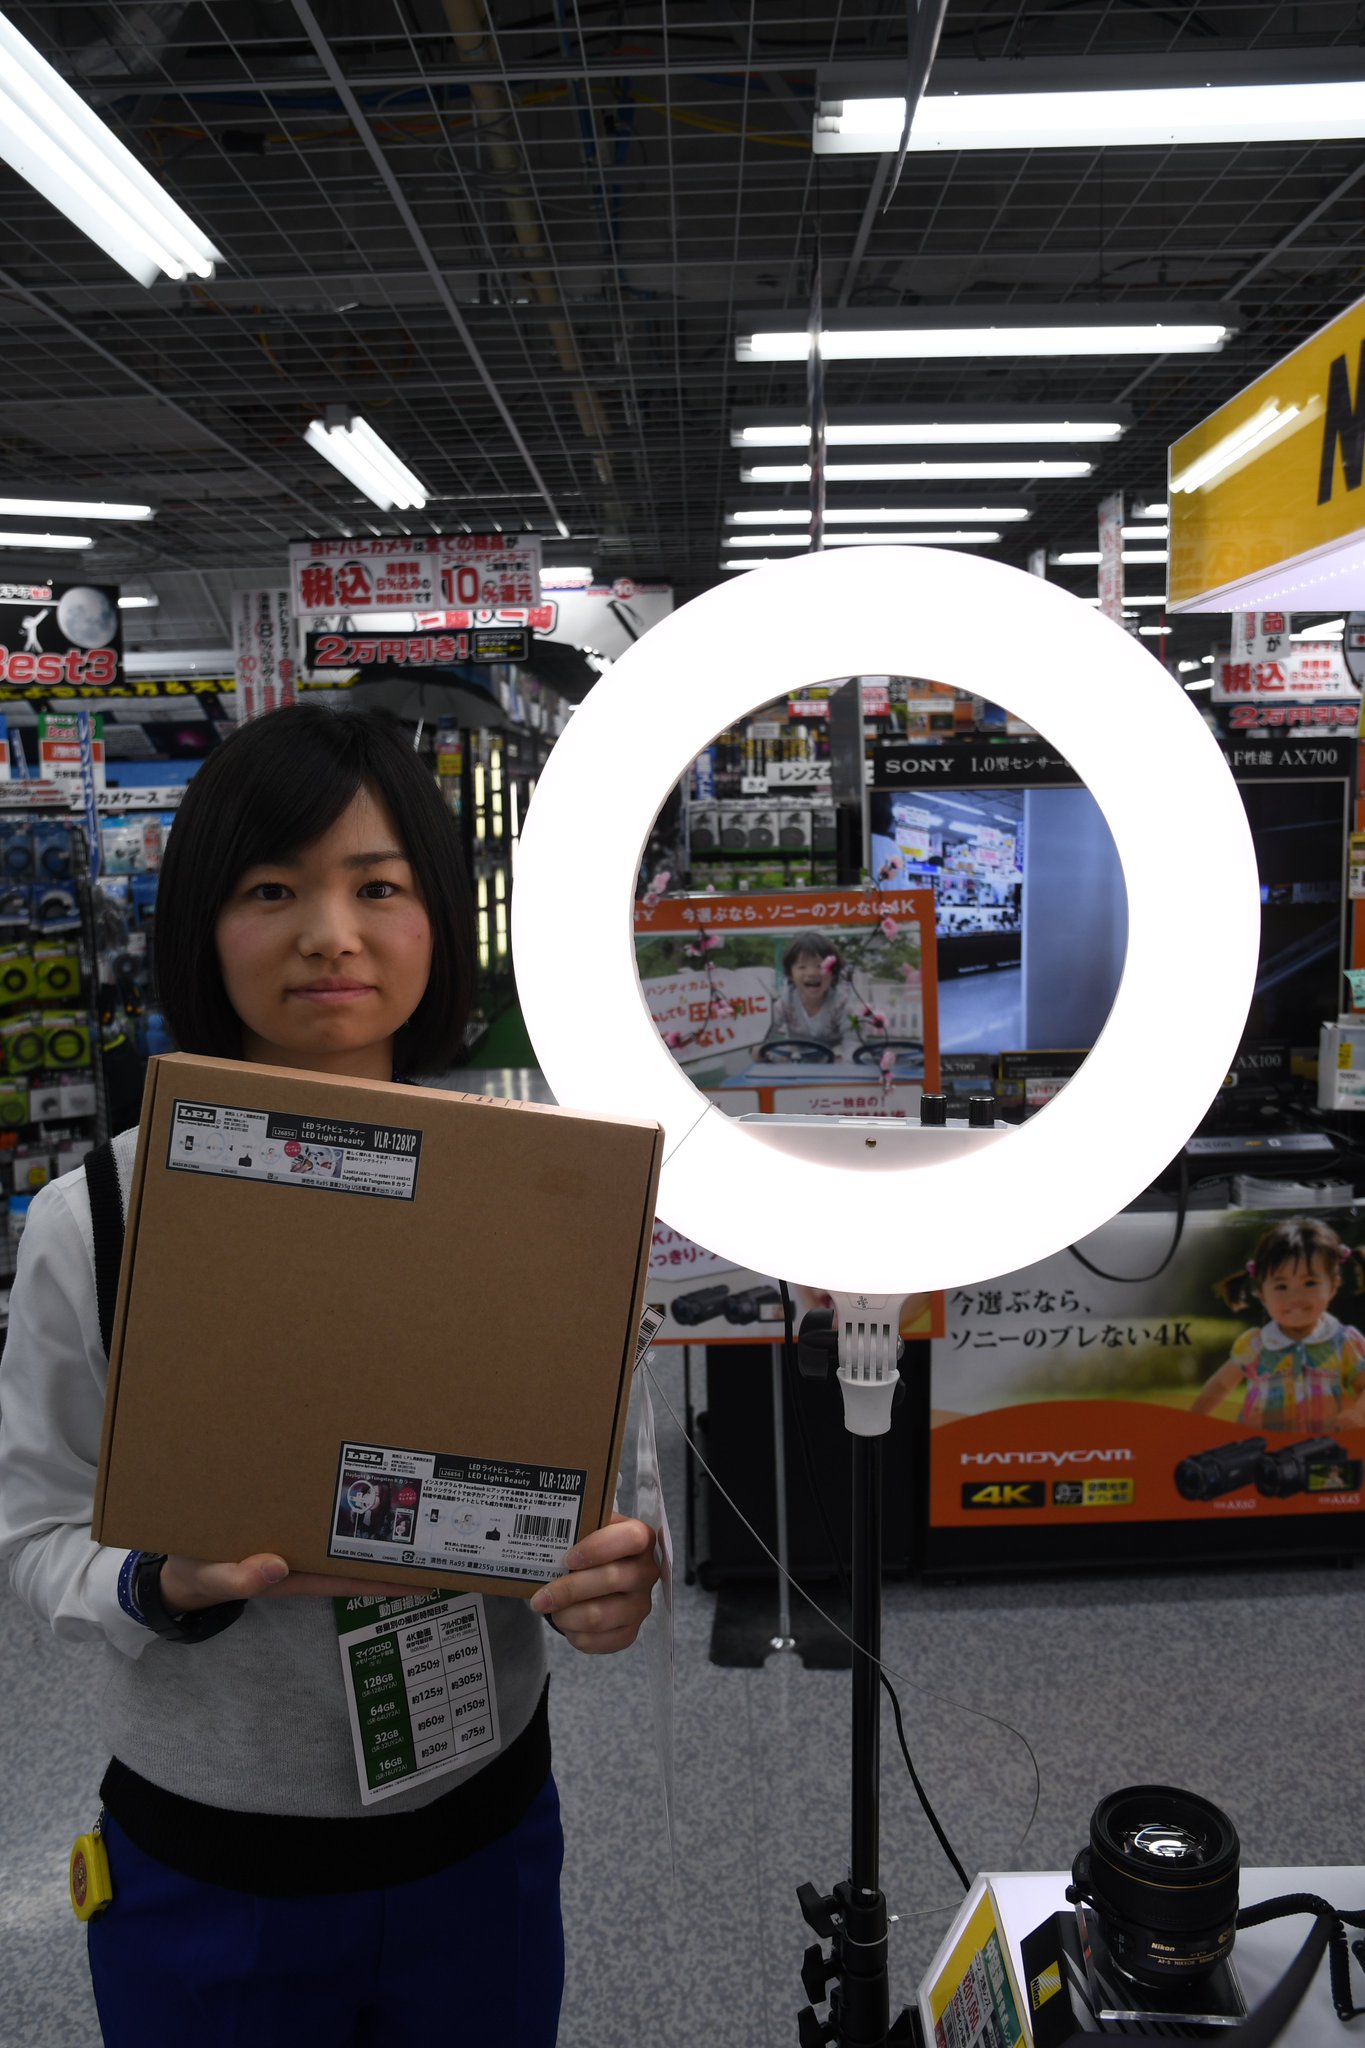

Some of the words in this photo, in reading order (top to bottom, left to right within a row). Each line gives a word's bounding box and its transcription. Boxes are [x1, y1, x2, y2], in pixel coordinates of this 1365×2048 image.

[301, 565, 373, 608] 税込
[1222, 662, 1285, 693] 税込
[885, 758, 955, 774] SONY
[1279, 750, 1338, 765] AX700
[1237, 1055, 1282, 1068] AX100
[274, 1129, 295, 1138] L26854
[302, 1122, 315, 1130] LED
[315, 1123, 366, 1135] ライトビューティー
[301, 1131, 316, 1140] LED
[317, 1133, 337, 1143] Light
[338, 1135, 366, 1147] Beauty
[374, 1130, 417, 1151] VLR-128XP
[342, 1174, 363, 1184] Daylight
[368, 1178, 391, 1187] Tungsten
[950, 1290, 1092, 1316] 今選ぶなら、
[950, 1323, 1192, 1350] ソニーのブレない4K
[960, 1449, 1132, 1466] HANDYCAM
[469, 1463, 481, 1471] LED
[482, 1464, 531, 1476] ライトビューティー
[467, 1472, 481, 1480] LED
[484, 1474, 503, 1483] Light
[504, 1476, 531, 1486] Beauty
[539, 1471, 581, 1491] VLR-128XP
[463, 1484, 486, 1492] Facebook
[971, 1484, 1031, 1505] 4K
[449, 1559, 466, 1568] Ra95
[521, 1567, 545, 1577] 最大出力
[440, 1614, 475, 1631] フルHD動画
[406, 1627, 432, 1642] 4K動画
[355, 1641, 392, 1659] マイクロSD
[448, 1645, 479, 1663] 約610分
[407, 1659, 441, 1677] 約250分
[363, 1673, 394, 1690] 128GB
[451, 1672, 483, 1690] 約305分
[411, 1686, 444, 1704] 約125分
[370, 1702, 395, 1717] 64GB
[455, 1698, 486, 1716] 約150分
[418, 1714, 445, 1731] 約60分
[374, 1729, 399, 1745] 32GB
[461, 1725, 486, 1742] 約75分
[421, 1741, 448, 1758] 約30分
[379, 1757, 403, 1771] 16GB
[1151, 1942, 1176, 1952] Nikon
[1031, 1978, 1042, 2009] Nikon
